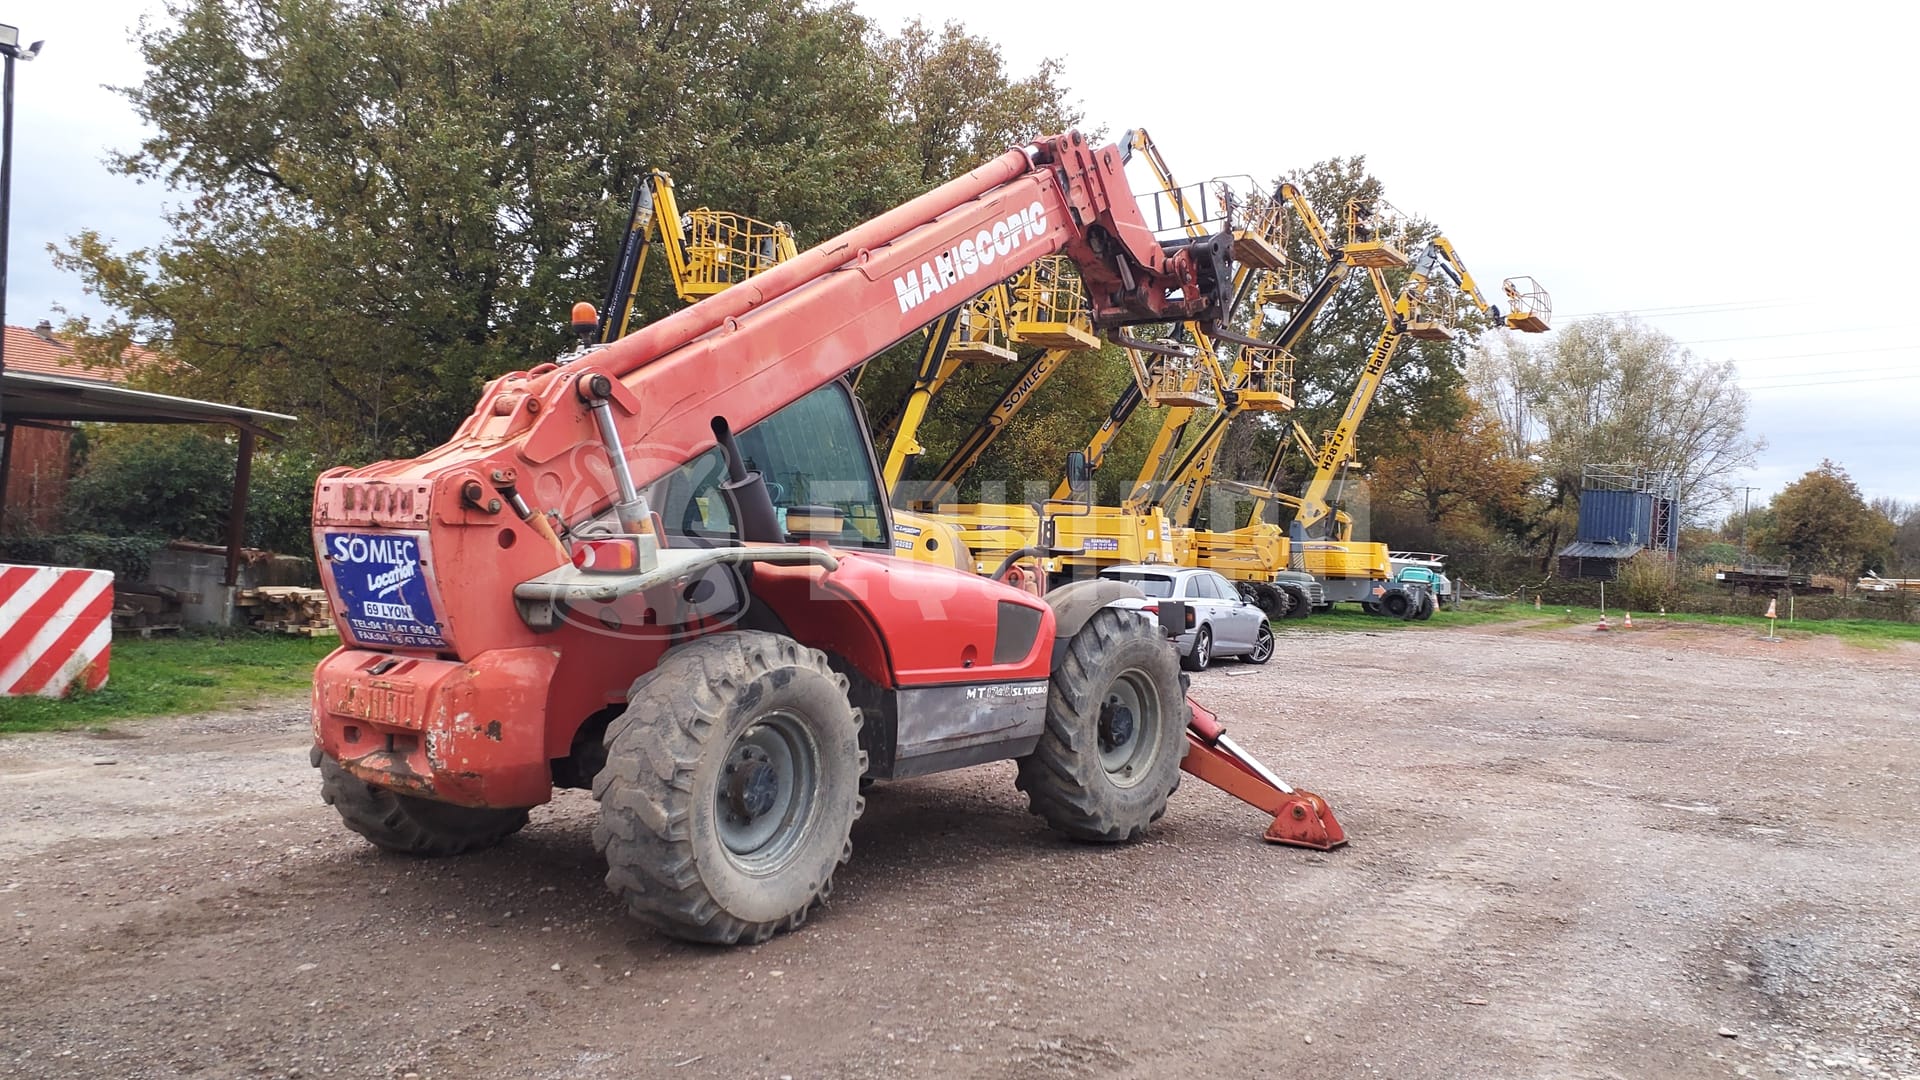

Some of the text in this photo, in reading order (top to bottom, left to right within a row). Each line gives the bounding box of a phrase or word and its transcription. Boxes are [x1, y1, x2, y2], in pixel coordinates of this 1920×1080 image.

[893, 201, 1047, 314] MANISCOPIC
[1367, 330, 1398, 376] Haulott
[1003, 361, 1048, 412] SOMLEC
[1322, 427, 1347, 471] H28TJ+
[1182, 478, 1198, 508] H21TX
[334, 536, 416, 566] SOMLEC
[367, 562, 416, 591] Location
[366, 603, 410, 618] 69 LYON
[966, 687, 986, 700] MT
[1012, 687, 1023, 697] SL
[1024, 686, 1048, 696] TURBO
